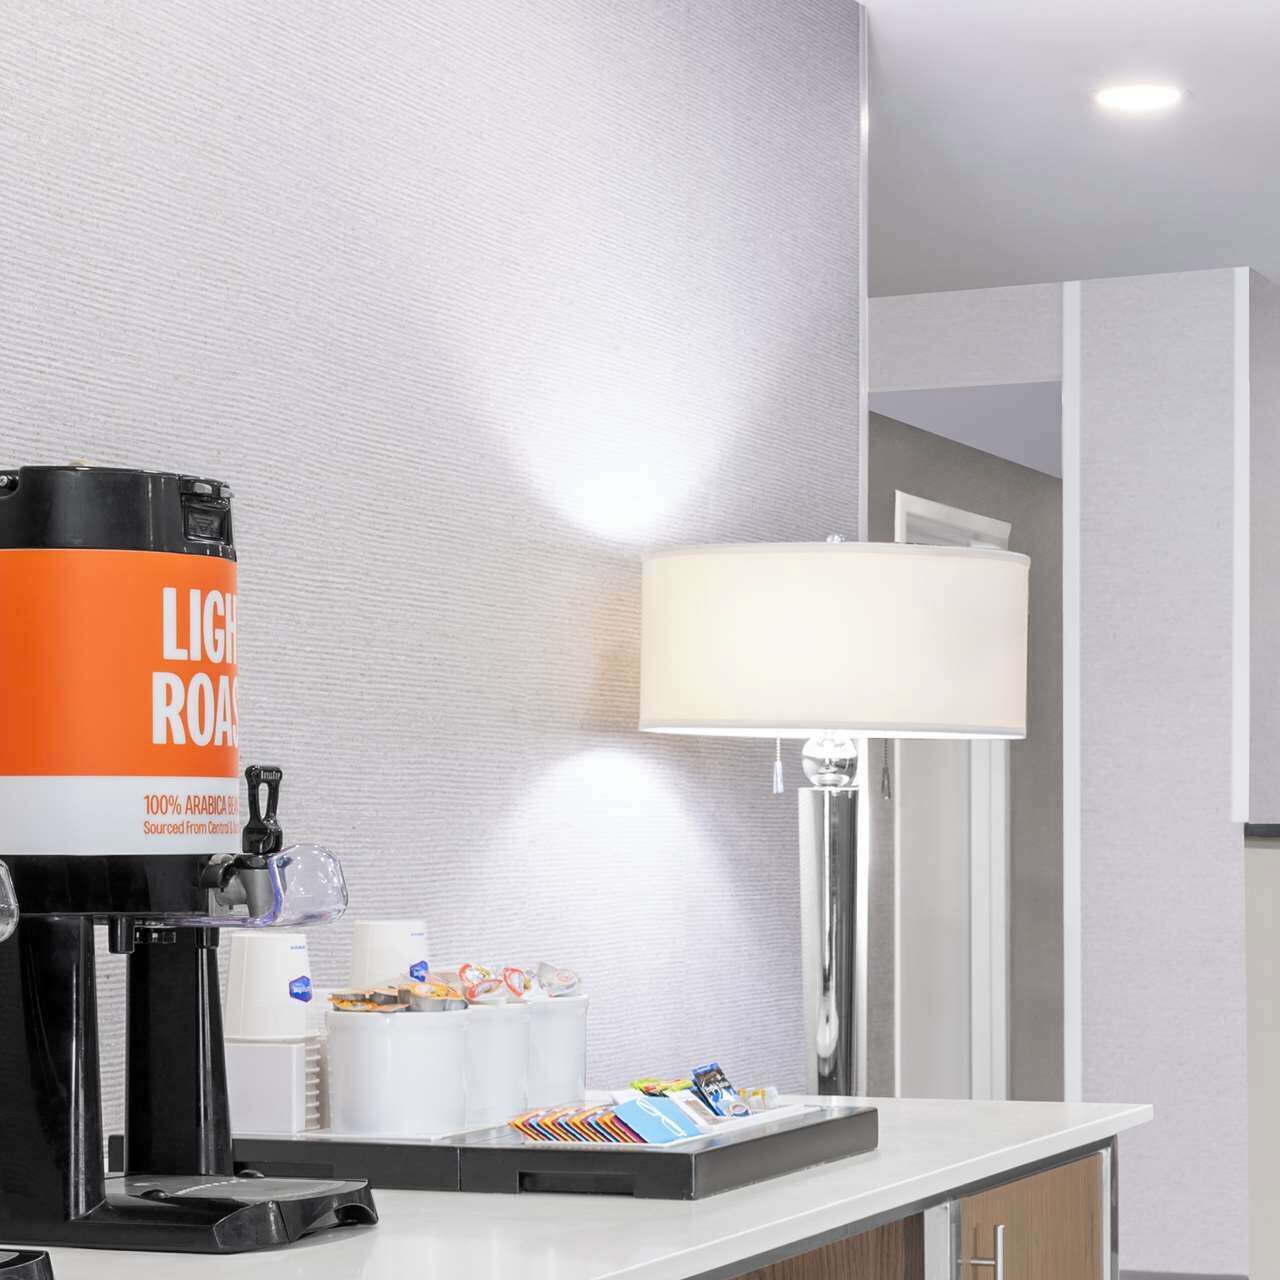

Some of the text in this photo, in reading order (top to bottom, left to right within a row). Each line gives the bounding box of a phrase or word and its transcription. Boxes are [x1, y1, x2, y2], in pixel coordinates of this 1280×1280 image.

[163, 587, 237, 665] LIGH
[152, 672, 238, 748] ROAS
[143, 794, 182, 815] 100%
[185, 795, 226, 815] ARABICA
[143, 821, 184, 835] Sourced
